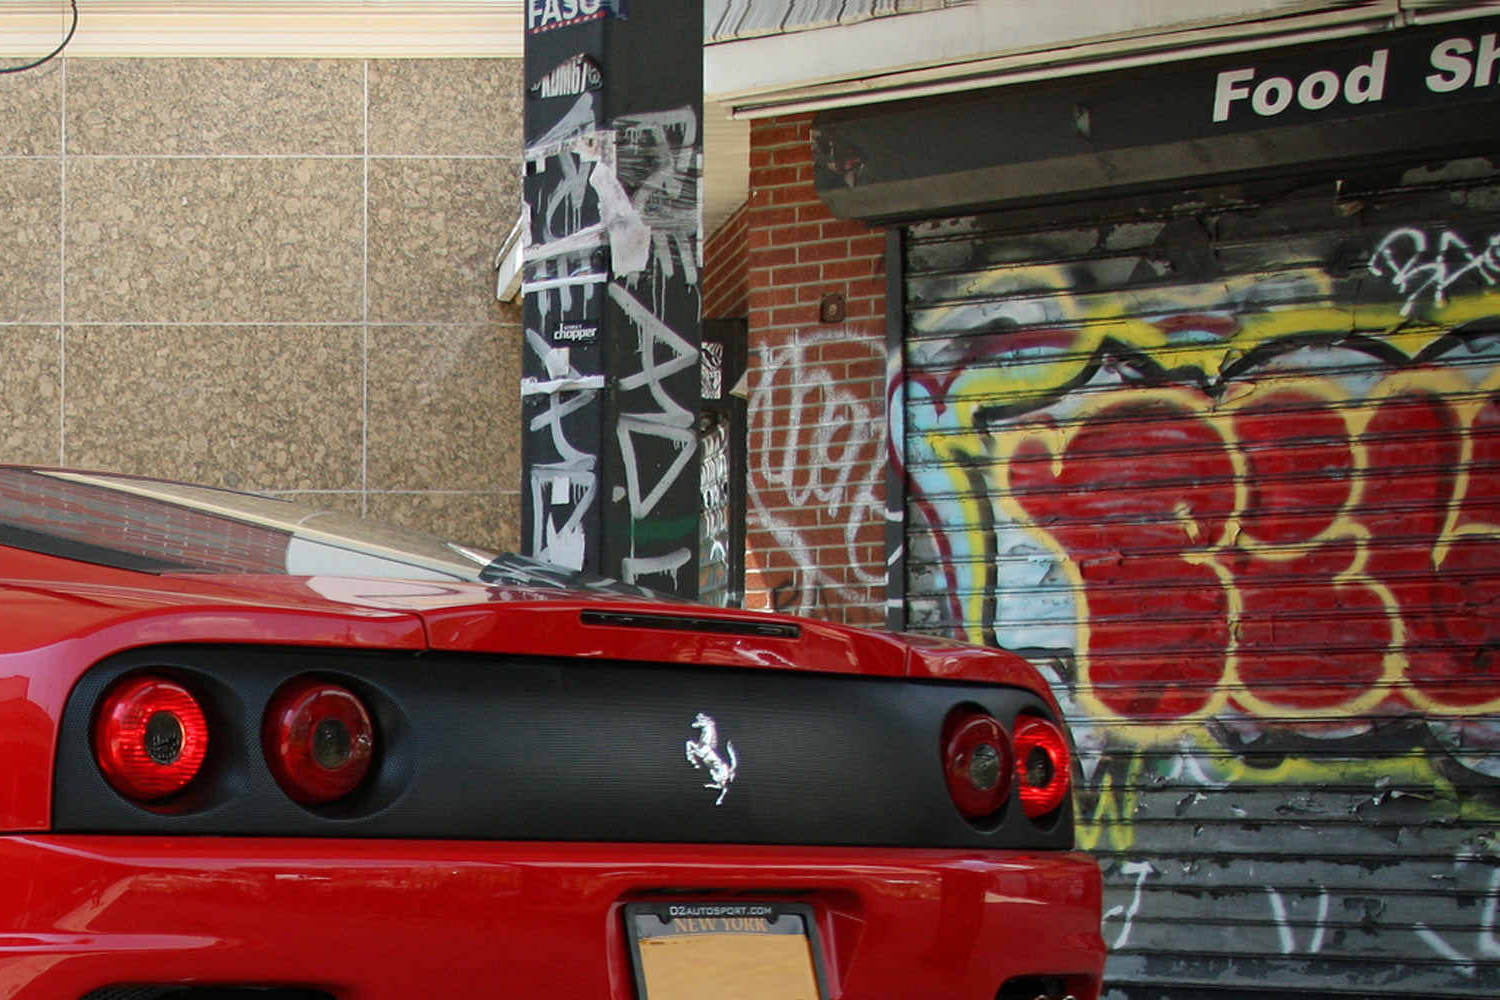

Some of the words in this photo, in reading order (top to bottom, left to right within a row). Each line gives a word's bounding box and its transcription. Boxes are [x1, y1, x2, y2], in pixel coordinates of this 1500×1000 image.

[1212, 49, 1389, 123] Food
[553, 323, 597, 341] chopper
[669, 906, 772, 916] D2AUTOSPORT.COM
[674, 917, 717, 933] NEW
[721, 917, 768, 932] YORK
